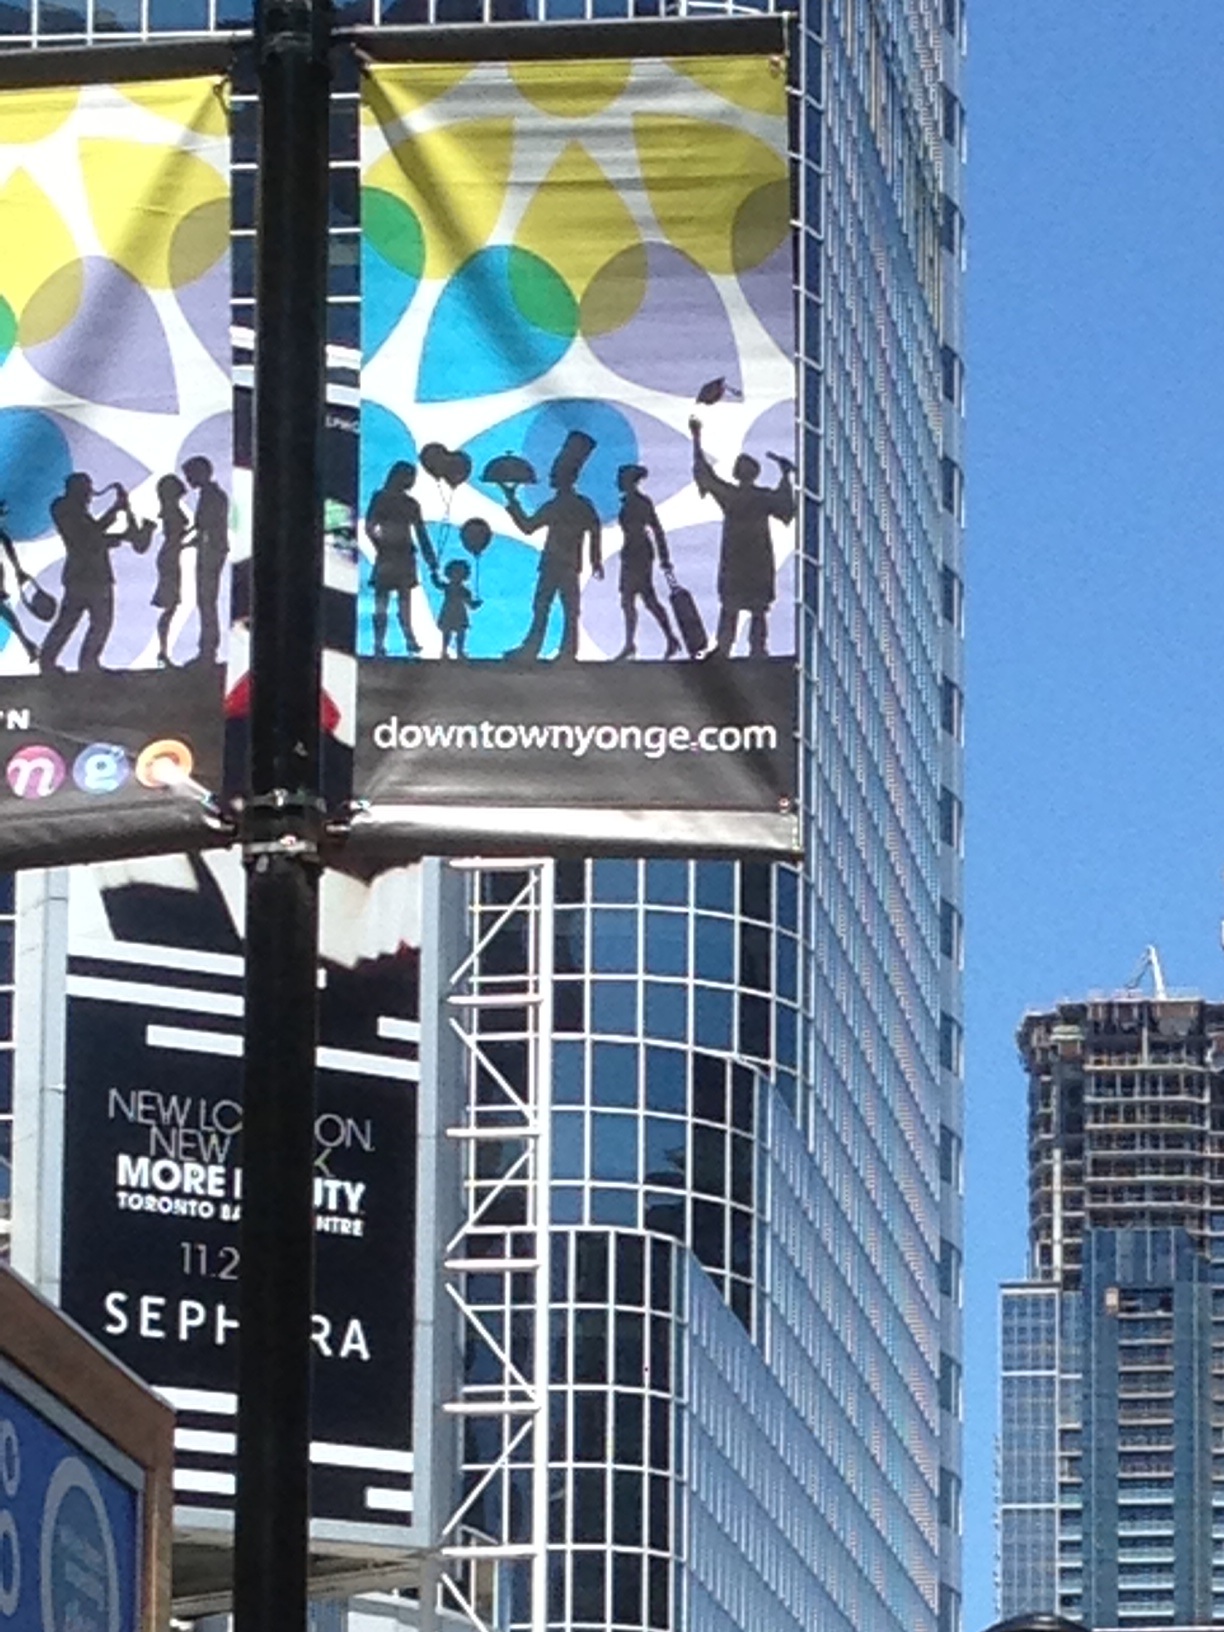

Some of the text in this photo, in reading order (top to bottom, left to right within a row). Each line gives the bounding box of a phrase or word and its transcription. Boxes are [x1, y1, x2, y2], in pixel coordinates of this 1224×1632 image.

[373, 716, 778, 759] downtownyonge.com
[108, 1087, 192, 1127] NEW
[150, 1125, 231, 1164] NEW
[116, 1153, 226, 1198] MORE
[116, 1191, 215, 1220] TORONTO
[104, 1290, 372, 1362] SEPHRA
